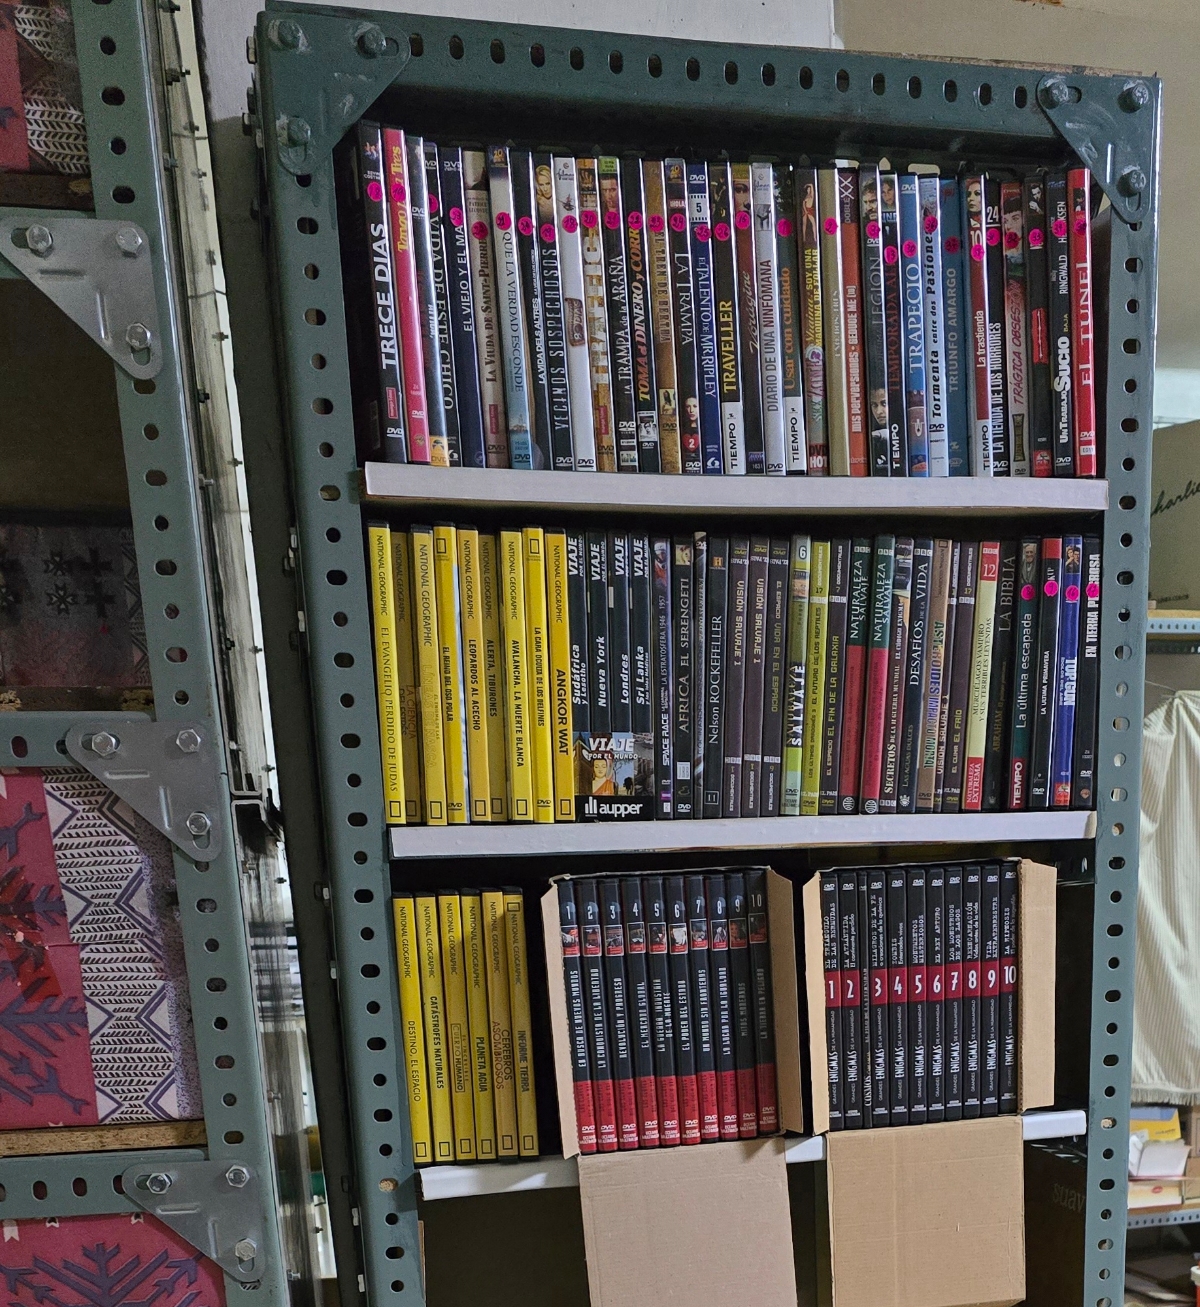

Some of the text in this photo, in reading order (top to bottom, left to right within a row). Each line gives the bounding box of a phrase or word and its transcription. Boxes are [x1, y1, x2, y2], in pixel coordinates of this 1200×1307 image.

[696, 202, 703, 213] 5
[987, 205, 999, 223] 24
[457, 252, 467, 265] EL
[457, 267, 468, 277] Y
[609, 255, 625, 300] ARAÑA
[1058, 254, 1069, 295] RINGWALD
[429, 216, 454, 410] VIDA DE ESTE CHICO
[459, 281, 471, 315] VIEJO
[502, 231, 524, 394] QUE LA VERDAD ESCONDE
[542, 249, 565, 357] SOSPECHOSOS
[631, 281, 648, 346] DINERO
[674, 253, 694, 346] LA TRAMPA
[696, 264, 713, 322] TALENTO
[904, 263, 925, 374] TRAPECIO
[1007, 281, 1023, 348] OBSESIÓN
[377, 291, 397, 370] TRECE
[464, 320, 473, 333] EL
[719, 299, 737, 394] TRAVELLER
[760, 259, 779, 412] DIARIO DE UNA NINFÓMANA
[780, 267, 796, 390] Usar con cuidado
[931, 319, 939, 344] entre
[945, 267, 959, 393] TRIUNFO AMARGO
[974, 310, 986, 368] La trastienda
[615, 331, 632, 382] TRAMPA
[636, 354, 652, 402] TOMA
[702, 356, 716, 398] RIPLEY
[929, 350, 943, 418] Tormenta
[1009, 355, 1024, 406] TRÁGICA
[1079, 364, 1093, 386] EL
[989, 322, 1004, 453] LA TIENDA DE LOS HORRORES
[688, 438, 695, 448] 2
[730, 422, 738, 469] TIEMPO
[568, 537, 578, 576] VIAJE
[615, 537, 626, 577] VIAJE
[799, 546, 806, 559] 6
[982, 564, 996, 578] 12
[419, 543, 433, 647] NATIONAL GEOGRAPHIC
[850, 559, 869, 639] NATURALEZA SALVAJE
[999, 555, 1016, 632] LA BIBLIA
[909, 562, 928, 686] DESAFÍOS VIDA
[1085, 610, 1099, 658] EN TIERRA
[486, 639, 498, 718] ALERTA, TIBURONES
[572, 644, 582, 705] Sudáfrica
[595, 636, 607, 708] Nueva York
[620, 653, 630, 705] Londres
[635, 645, 646, 705] Sri Lanka
[677, 578, 690, 734] AFRICA EL SERENGETI
[708, 615, 722, 745] Nelson ROCKEFELLER
[1016, 613, 1034, 729] La última escapada
[381, 627, 399, 792] EL EVANGELIO PERDIDO DE JUDAS
[468, 639, 481, 732] LEOPARDOS AL ACECHO
[511, 639, 525, 768] AVALANCHA. LA MUERTE BLANCA
[556, 668, 569, 756] ANGKOR WAT
[588, 737, 635, 752] VIAJE
[661, 713, 671, 767] SPACE RACE
[599, 801, 643, 818] aupper
[966, 762, 981, 804] NATURALEZA EXTREMA
[1013, 761, 1023, 807] TIEMPO
[751, 893, 763, 908] 10
[828, 980, 835, 999] 1
[915, 975, 923, 994] 5
[968, 969, 977, 989] 8
[1003, 965, 1017, 985] 10
[408, 1020, 421, 1103] DESTINO, EL ESPACIO
[429, 995, 445, 1090] CATÁSTROFES NATURALES
[475, 1036, 488, 1093] PLANETA AGUA
[492, 1020, 513, 1090] CEREBROS ASOMBROSOS
[517, 1030, 530, 1093] INFORME TIERRA
[829, 1051, 838, 1083] ENIGMAS
[933, 1044, 943, 1076] ENIGMAS
